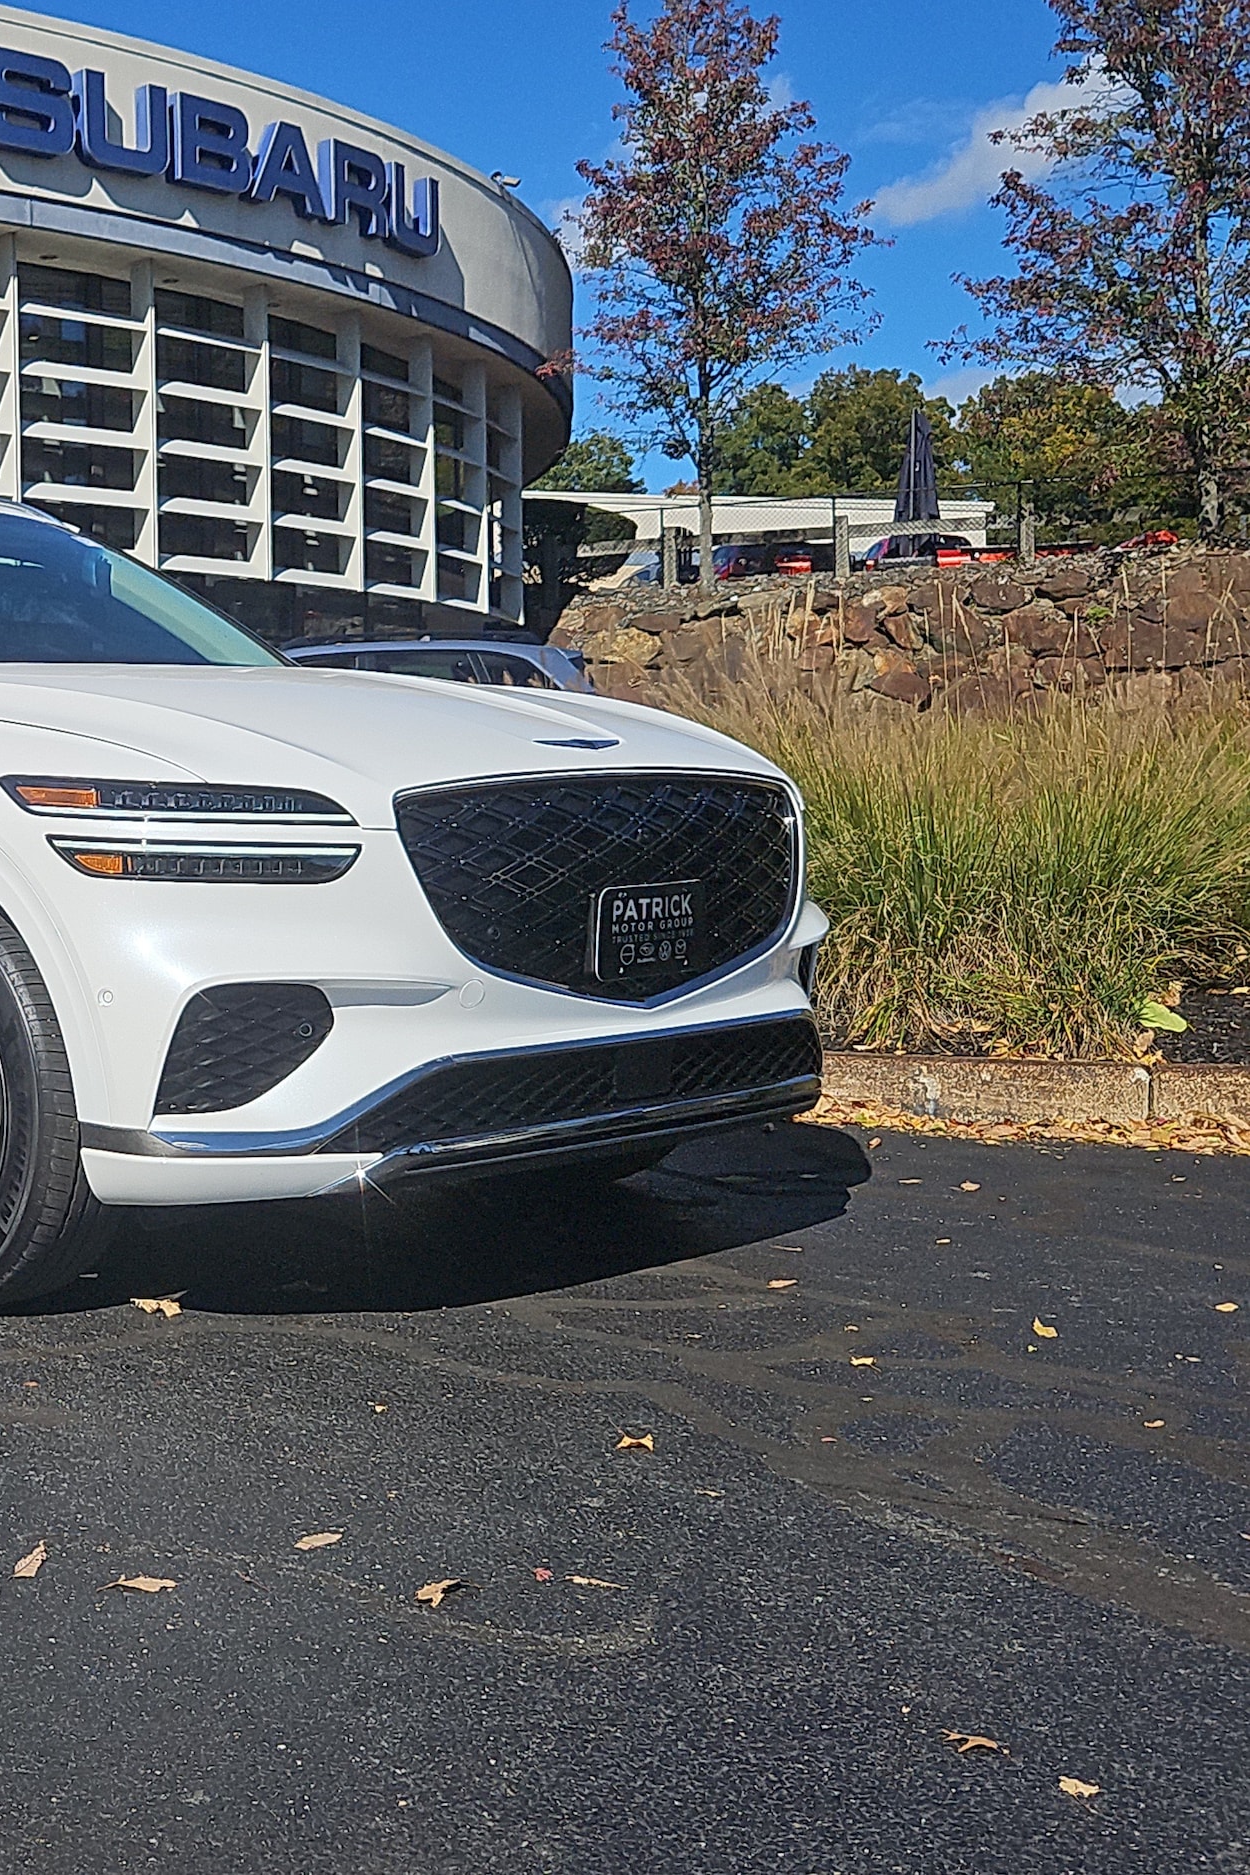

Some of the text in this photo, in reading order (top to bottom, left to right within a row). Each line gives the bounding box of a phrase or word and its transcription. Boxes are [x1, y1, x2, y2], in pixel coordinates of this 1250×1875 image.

[612, 893, 692, 922] PATRICK
[612, 917, 693, 934] MOTOR GROUP
